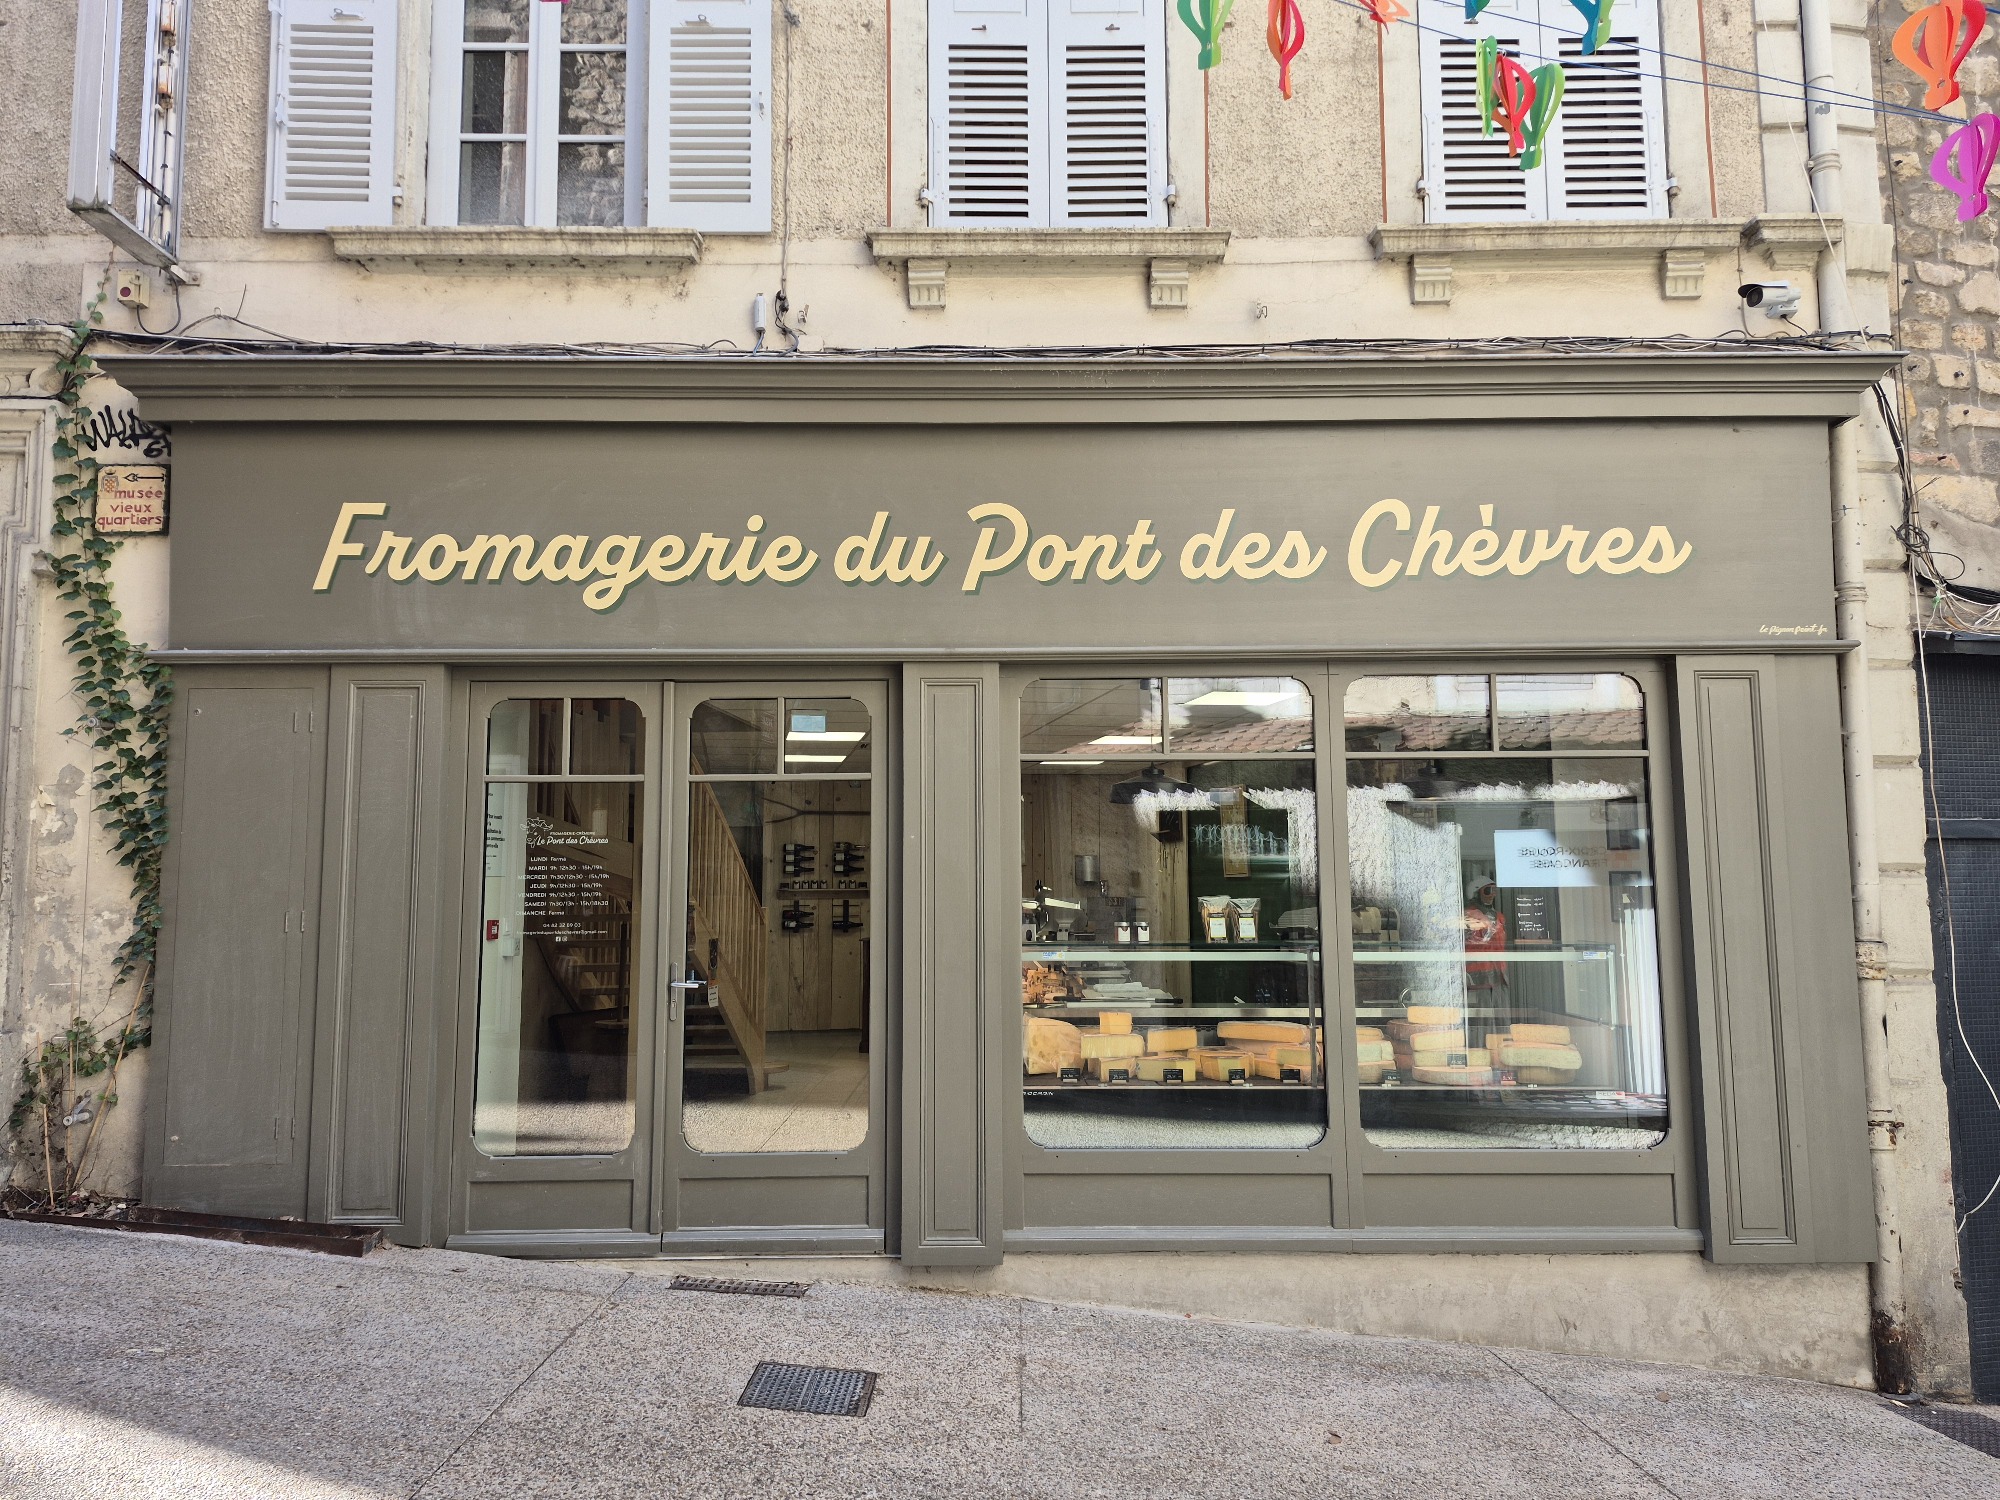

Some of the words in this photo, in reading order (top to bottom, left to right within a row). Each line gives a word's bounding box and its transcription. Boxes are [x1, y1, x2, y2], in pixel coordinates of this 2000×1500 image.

[114, 486, 163, 499] musée
[110, 502, 152, 513] vieux
[97, 514, 162, 529] quartiers
[312, 502, 819, 610] Fromagerie
[833, 511, 945, 583] du
[961, 503, 1161, 592] Pont
[1179, 508, 1328, 580] des
[1347, 498, 1693, 588] Chèvres
[537, 836, 548, 845] Le
[547, 836, 565, 845] Pont
[565, 836, 578, 844] des
[579, 836, 609, 845] Chèvres
